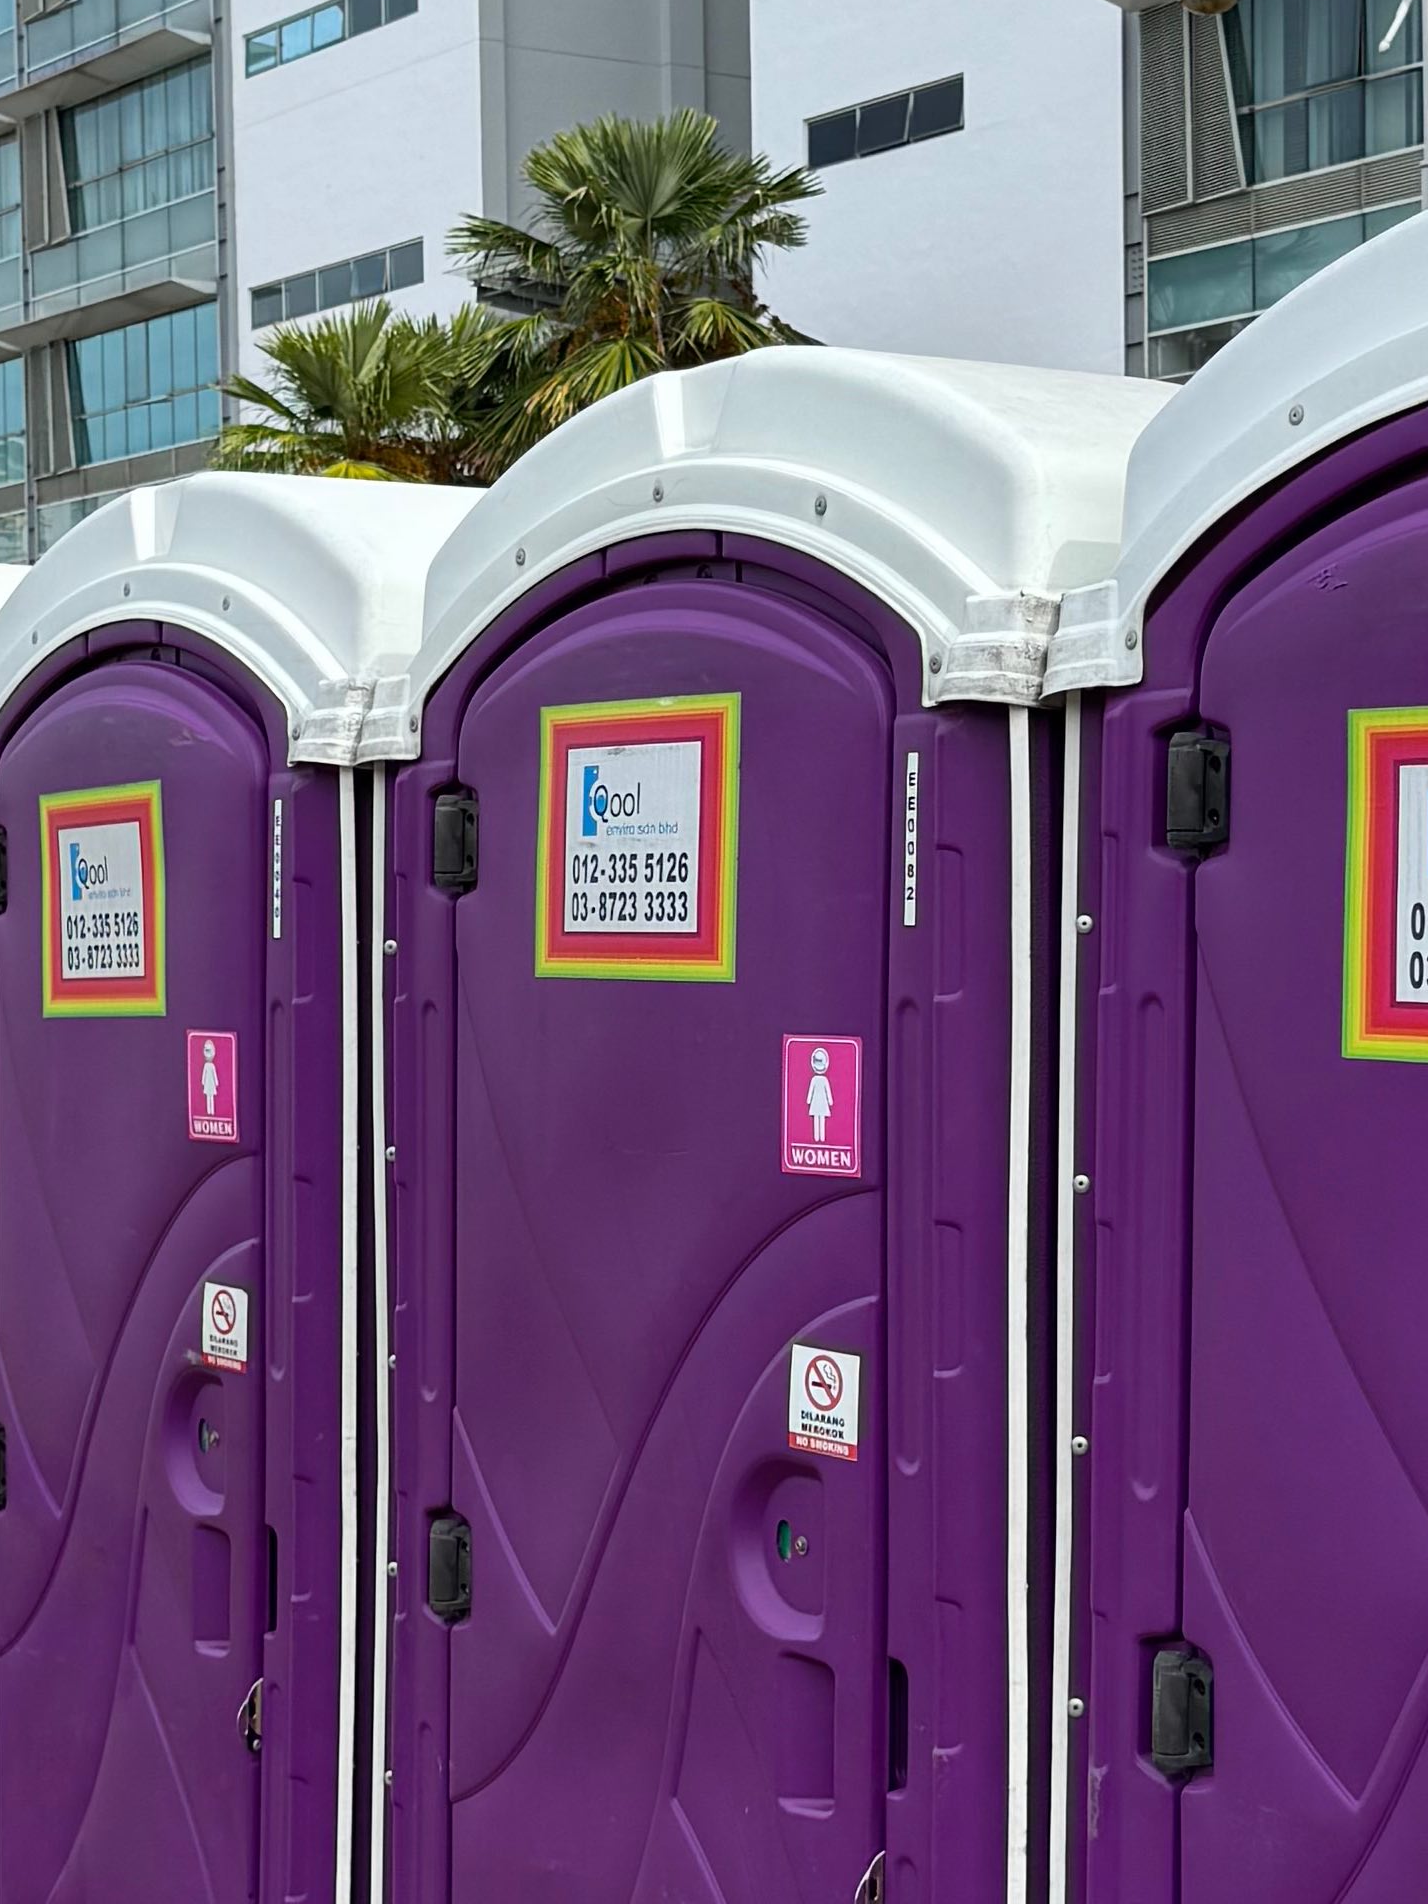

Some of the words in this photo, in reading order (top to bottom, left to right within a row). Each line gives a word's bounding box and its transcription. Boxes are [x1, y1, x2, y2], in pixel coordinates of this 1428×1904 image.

[606, 823, 635, 836] enviro
[638, 824, 656, 836] sdn
[658, 821, 679, 835] bhd
[572, 852, 638, 884] 012-335
[644, 851, 689, 884] 5126
[572, 890, 638, 923] 03-8723
[644, 890, 689, 923] 3333
[66, 912, 111, 940] 012-335
[114, 911, 139, 938] 5126
[116, 942, 140, 969] 3333
[791, 1148, 852, 1168] WOMEN
